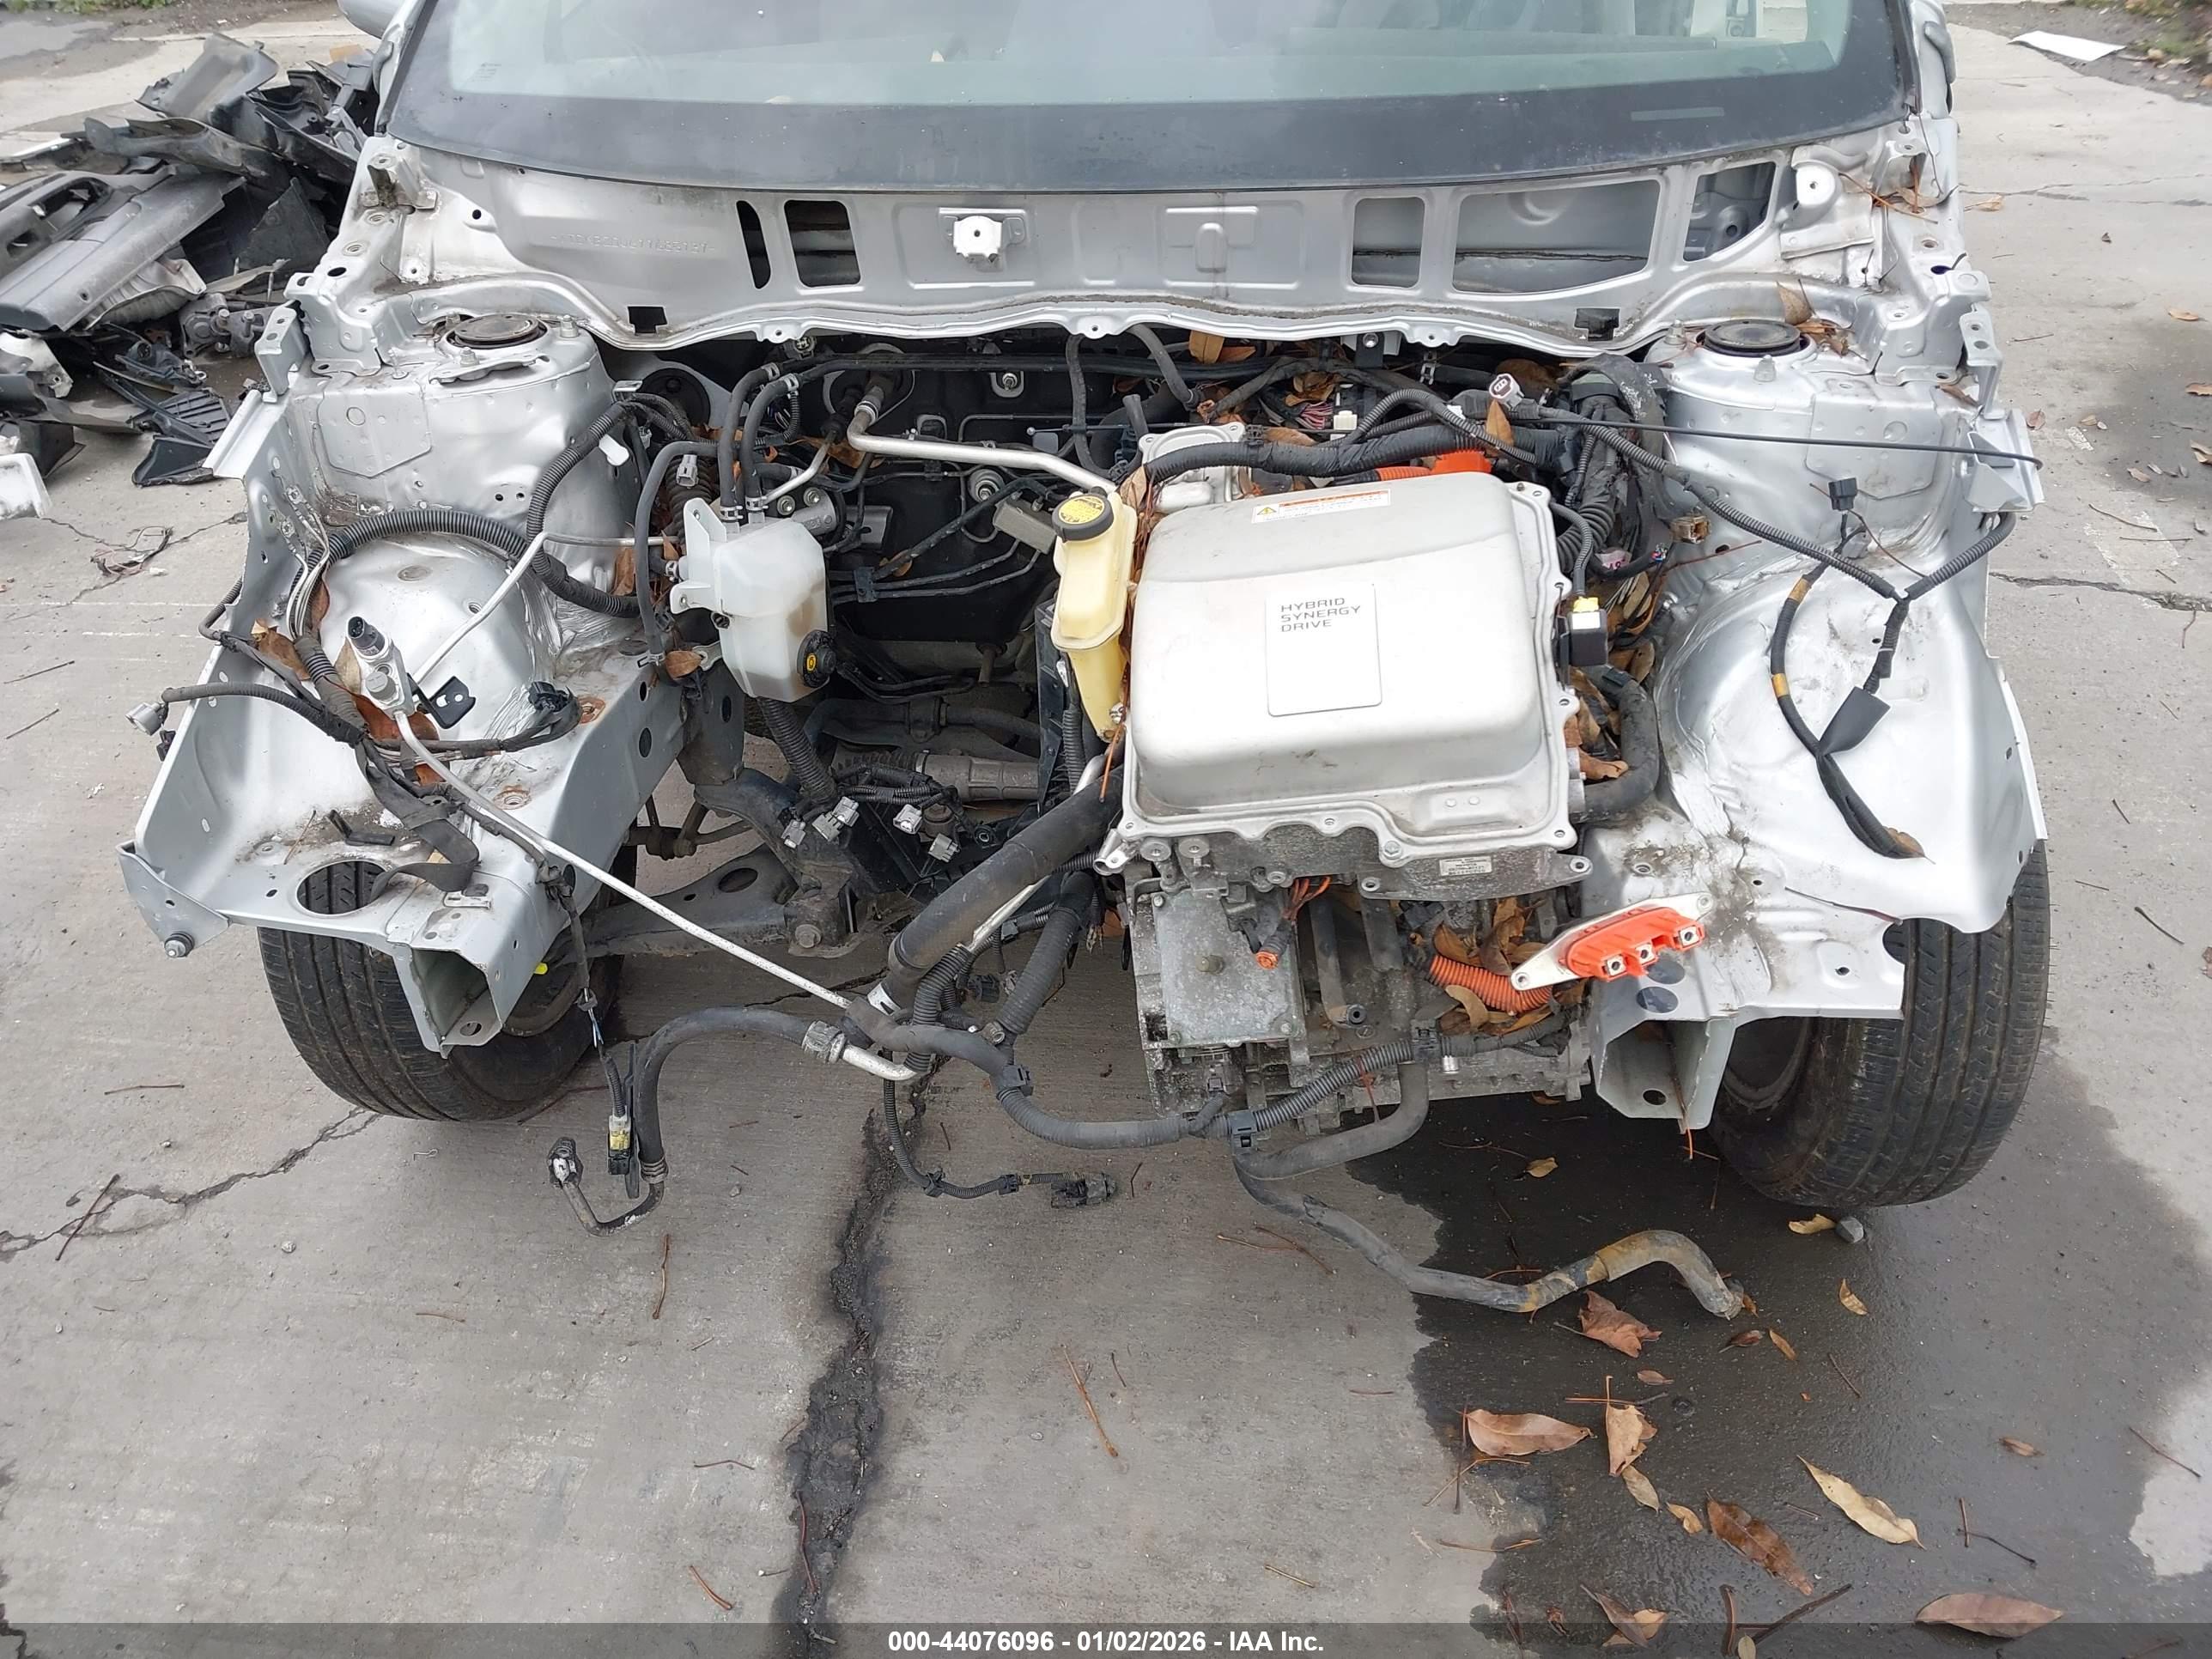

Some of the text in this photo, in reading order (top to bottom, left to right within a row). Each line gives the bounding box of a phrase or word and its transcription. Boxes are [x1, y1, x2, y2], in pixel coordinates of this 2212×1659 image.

[1280, 597, 1346, 613] HYBRID
[1280, 605, 1361, 623] SYNERGY
[1280, 619, 1333, 632] DRIVE
